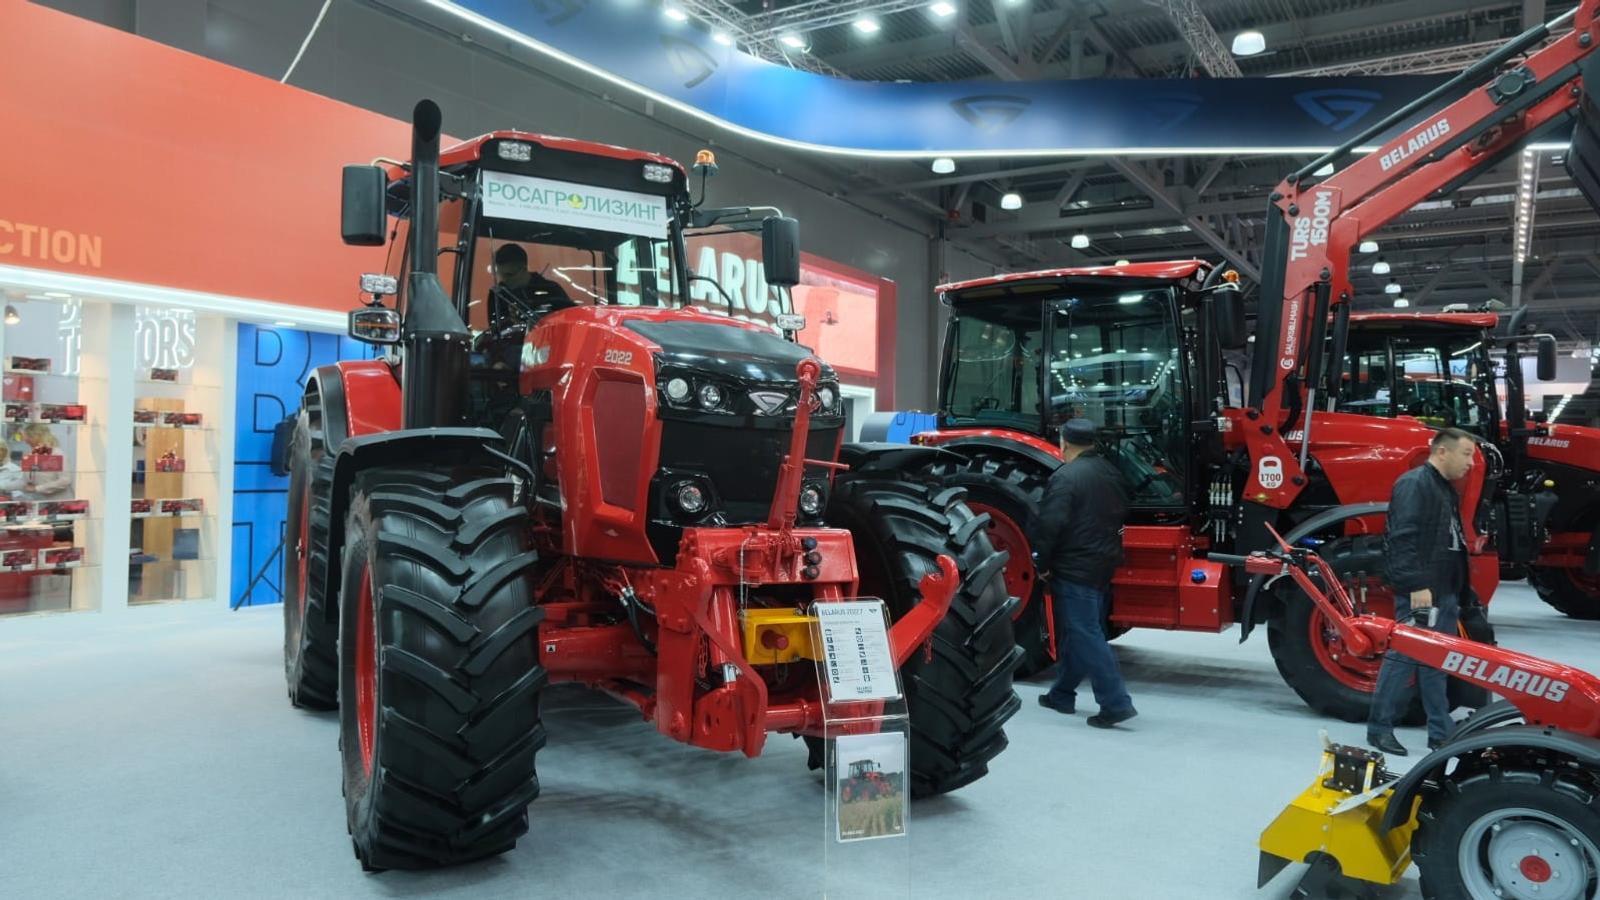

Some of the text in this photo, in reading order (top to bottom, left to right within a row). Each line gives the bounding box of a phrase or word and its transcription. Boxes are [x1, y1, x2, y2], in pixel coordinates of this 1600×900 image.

[1380, 118, 1450, 171] BELARUS
[488, 181, 662, 222] РОСАГРОЛИЗИНГ
[1309, 190, 1332, 246] 1500M
[1291, 217, 1310, 261] TURS
[604, 349, 633, 365] 2022
[1527, 436, 1570, 448] BELARUS
[1260, 473, 1281, 482] 1700
[1441, 651, 1570, 702] BELARUS
